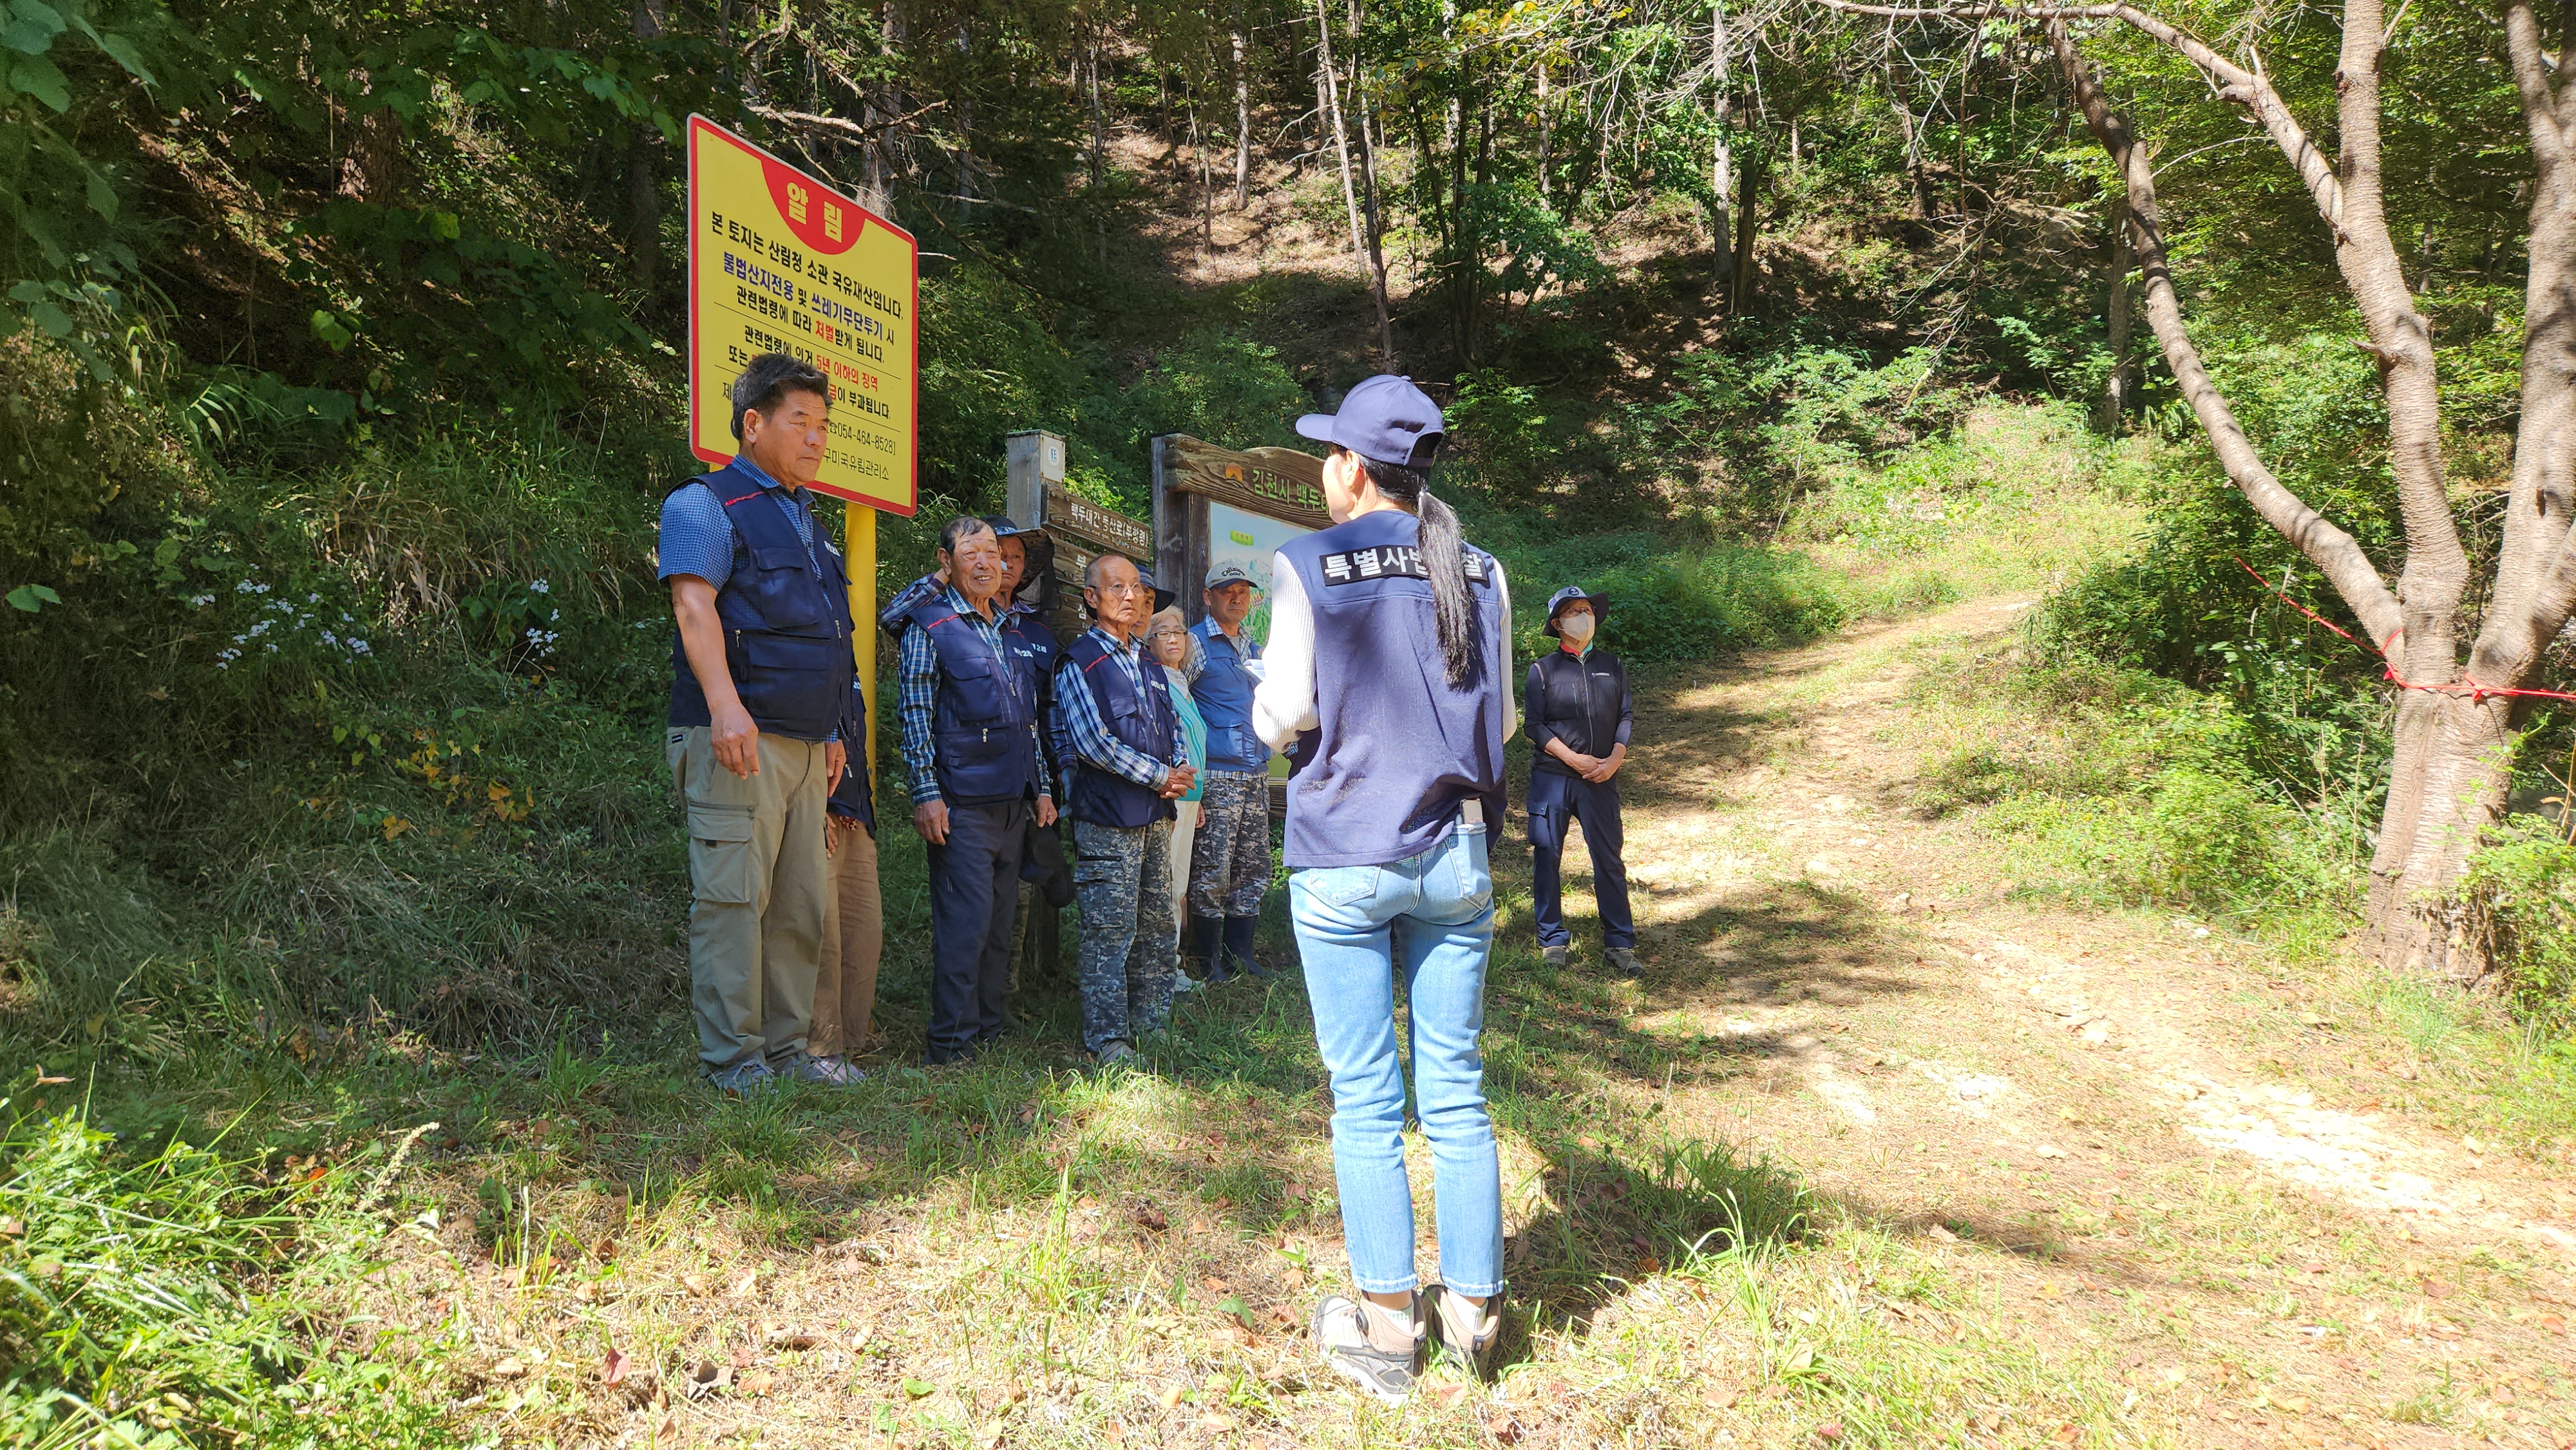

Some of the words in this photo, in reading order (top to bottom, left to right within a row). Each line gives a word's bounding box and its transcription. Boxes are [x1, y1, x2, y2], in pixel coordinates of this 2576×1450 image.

[712, 211, 723, 236] 본
[729, 220, 764, 256] 토지는
[769, 240, 802, 273] 산림청
[808, 259, 828, 286] 소관
[833, 270, 903, 320] 국유재산입니다.
[724, 250, 793, 301] 불법산지전용
[798, 287, 806, 308] 및
[811, 292, 882, 341] 쓰레기무단투기
[887, 328, 894, 346] 시
[737, 285, 788, 324] 관련법령에
[793, 310, 811, 334] 따라
[815, 320, 852, 351] 처벌받게
[857, 337, 884, 363] 됩니다.
[729, 344, 748, 368] 또는
[849, 390, 891, 419] 부과됩니다.
[744, 325, 791, 356] 관련법령에
[817, 354, 830, 374] 5년
[834, 361, 858, 385] 이하의
[862, 372, 878, 392] 징역
[823, 447, 889, 480] 구미국유림관리소
[1253, 469, 1289, 504] 김천시
[1297, 484, 1329, 514] 백두대
[1071, 502, 1100, 529] 백두대간
[1325, 547, 1482, 579] 특별사법찰
